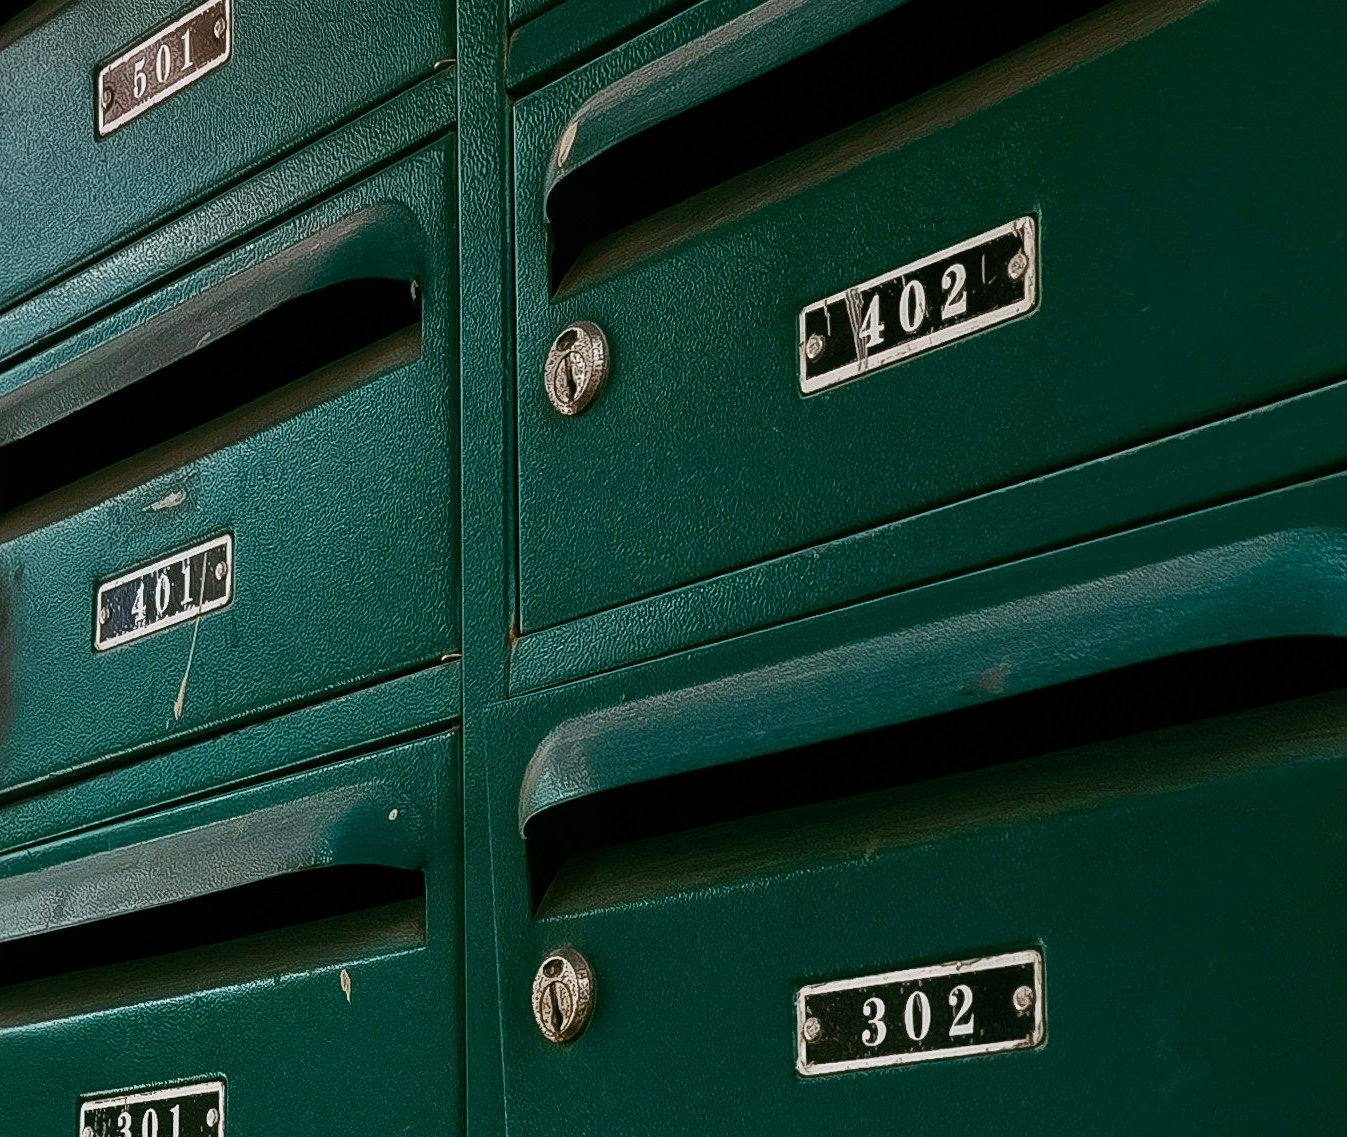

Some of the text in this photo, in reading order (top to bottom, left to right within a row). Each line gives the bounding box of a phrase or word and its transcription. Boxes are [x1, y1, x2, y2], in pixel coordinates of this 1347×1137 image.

[132, 28, 194, 99] 501
[858, 263, 969, 348] 402
[131, 565, 194, 623] 401
[861, 984, 975, 1047] 302
